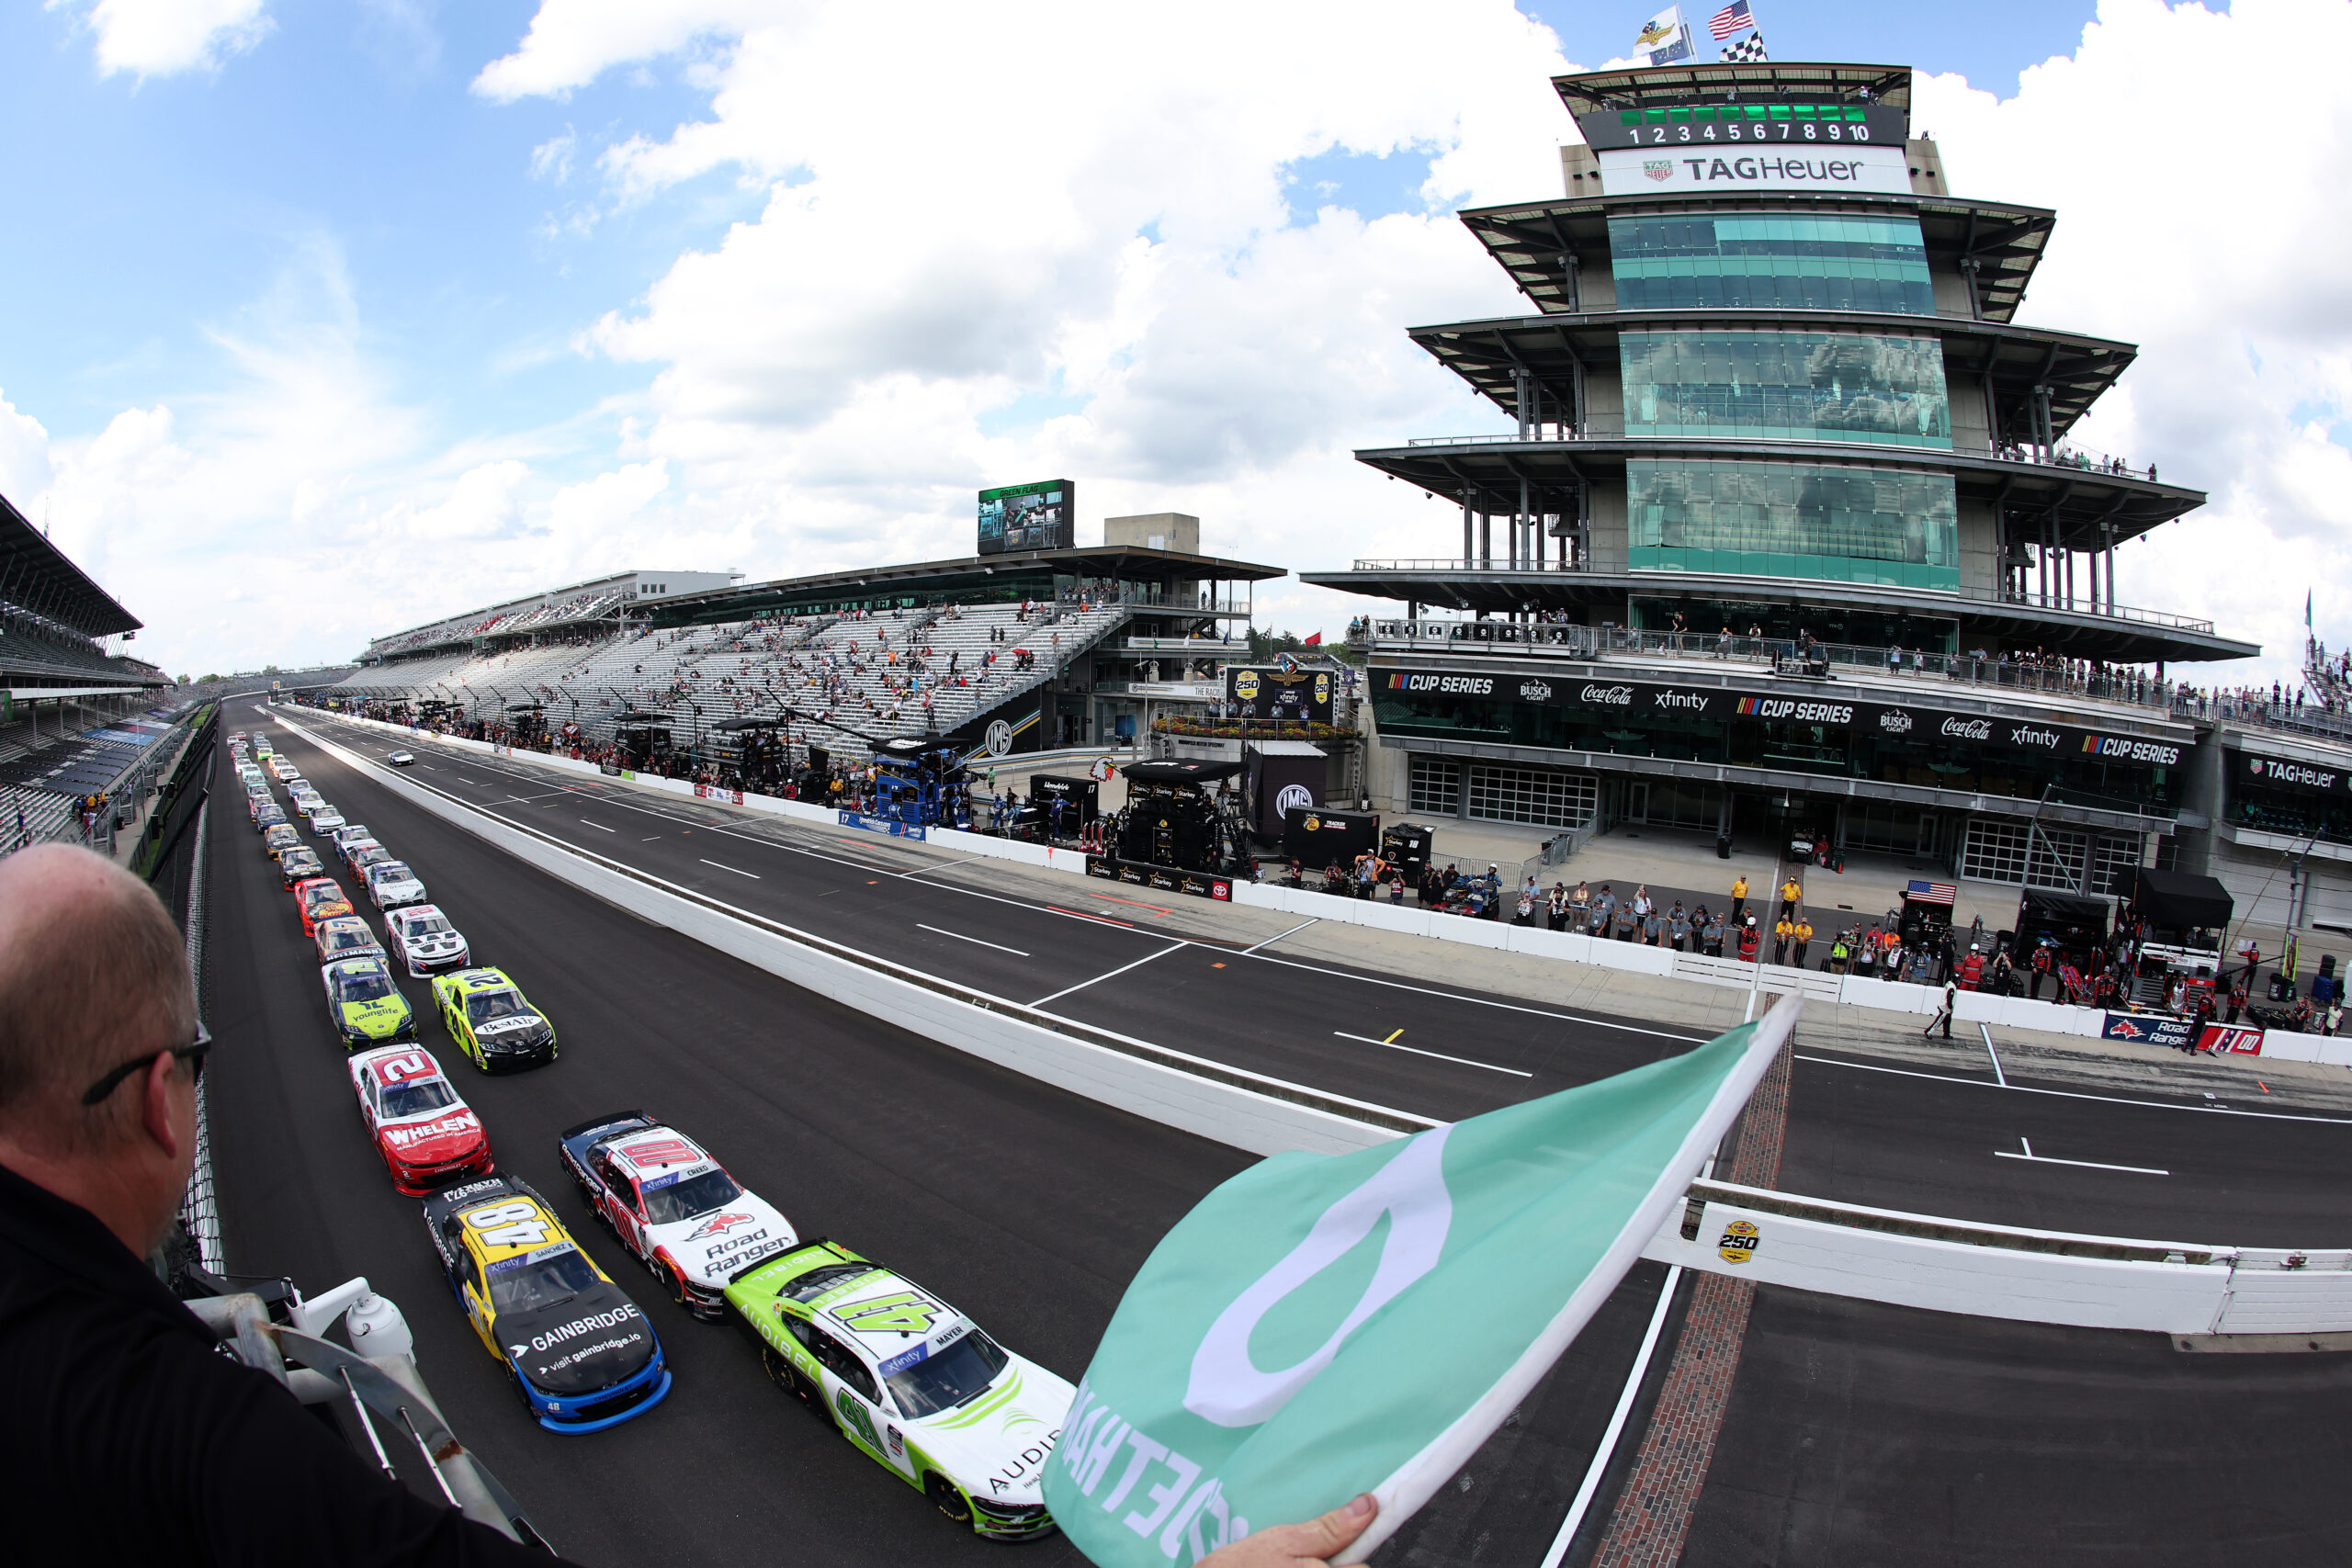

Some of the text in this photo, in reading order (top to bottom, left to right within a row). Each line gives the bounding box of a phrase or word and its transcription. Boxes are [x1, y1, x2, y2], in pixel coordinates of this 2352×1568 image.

[1630, 124, 1870, 144] 1 2 3 4 5 6 7 8 9 10
[1647, 161, 1669, 169] TAG
[1645, 168, 1673, 180] HEUER
[1000, 485, 1039, 497] GREEN FLAG
[1195, 687, 1205, 695] THE
[1236, 680, 1259, 689] 250
[1316, 683, 1329, 693] 250
[1409, 674, 1493, 694] CUP SERIES
[1521, 684, 1552, 698] BUSCH
[1279, 694, 1299, 702] xfinity
[1580, 683, 1634, 705] Coca-Cola
[1655, 690, 1709, 711] xfinity
[1760, 699, 1853, 724] CUP SERIES
[1880, 715, 1913, 729] BUSCH
[1941, 716, 1993, 740] Coca-Cola
[2011, 726, 2061, 749] xfinity
[2102, 738, 2179, 765] CUP SERIES
[1088, 784, 1096, 794] 17
[1156, 787, 1173, 796] Starkey
[1178, 790, 1195, 799] Starkey
[841, 813, 850, 824] 17
[1408, 840, 1419, 849] 18
[1093, 866, 1111, 876] Starkey
[1123, 872, 1141, 882] Starkey
[1153, 877, 1172, 887] Starkey
[1185, 883, 1205, 894] Starkey
[463, 973, 505, 988] 20
[353, 1008, 399, 1021] younglife
[483, 1017, 535, 1033] BestAir
[2157, 1021, 2191, 1034] Road
[2148, 1032, 2188, 1046] Range
[2237, 1034, 2260, 1051] 00
[383, 1054, 426, 1082] 2
[384, 1111, 479, 1145] WHELEN
[396, 1134, 446, 1151] MANUFACTURED
[454, 1128, 481, 1136] AMERICA
[434, 1163, 461, 1173] CHEVROLET
[577, 1164, 603, 1194] Ranger
[646, 1165, 708, 1190] xfinity CREED
[466, 1201, 551, 1247] 48
[426, 1214, 456, 1274] GAINBRIDGE
[706, 1228, 768, 1259] Road
[1719, 1235, 1759, 1250] 250
[491, 1244, 566, 1272] xfinity SANCHEZ
[704, 1236, 793, 1279] Ranger
[751, 1248, 826, 1282] AUDIBEL
[811, 1270, 885, 1305] AUDIBEL
[829, 1291, 944, 1334] 41
[531, 1303, 640, 1352] GAINBRIDGE
[549, 1332, 641, 1371] visit gainbridge.io
[740, 1303, 819, 1383] AUDIBEL
[888, 1325, 964, 1371] xfinity MAYER
[548, 1403, 560, 1411] 48
[837, 1387, 890, 1459] 41
